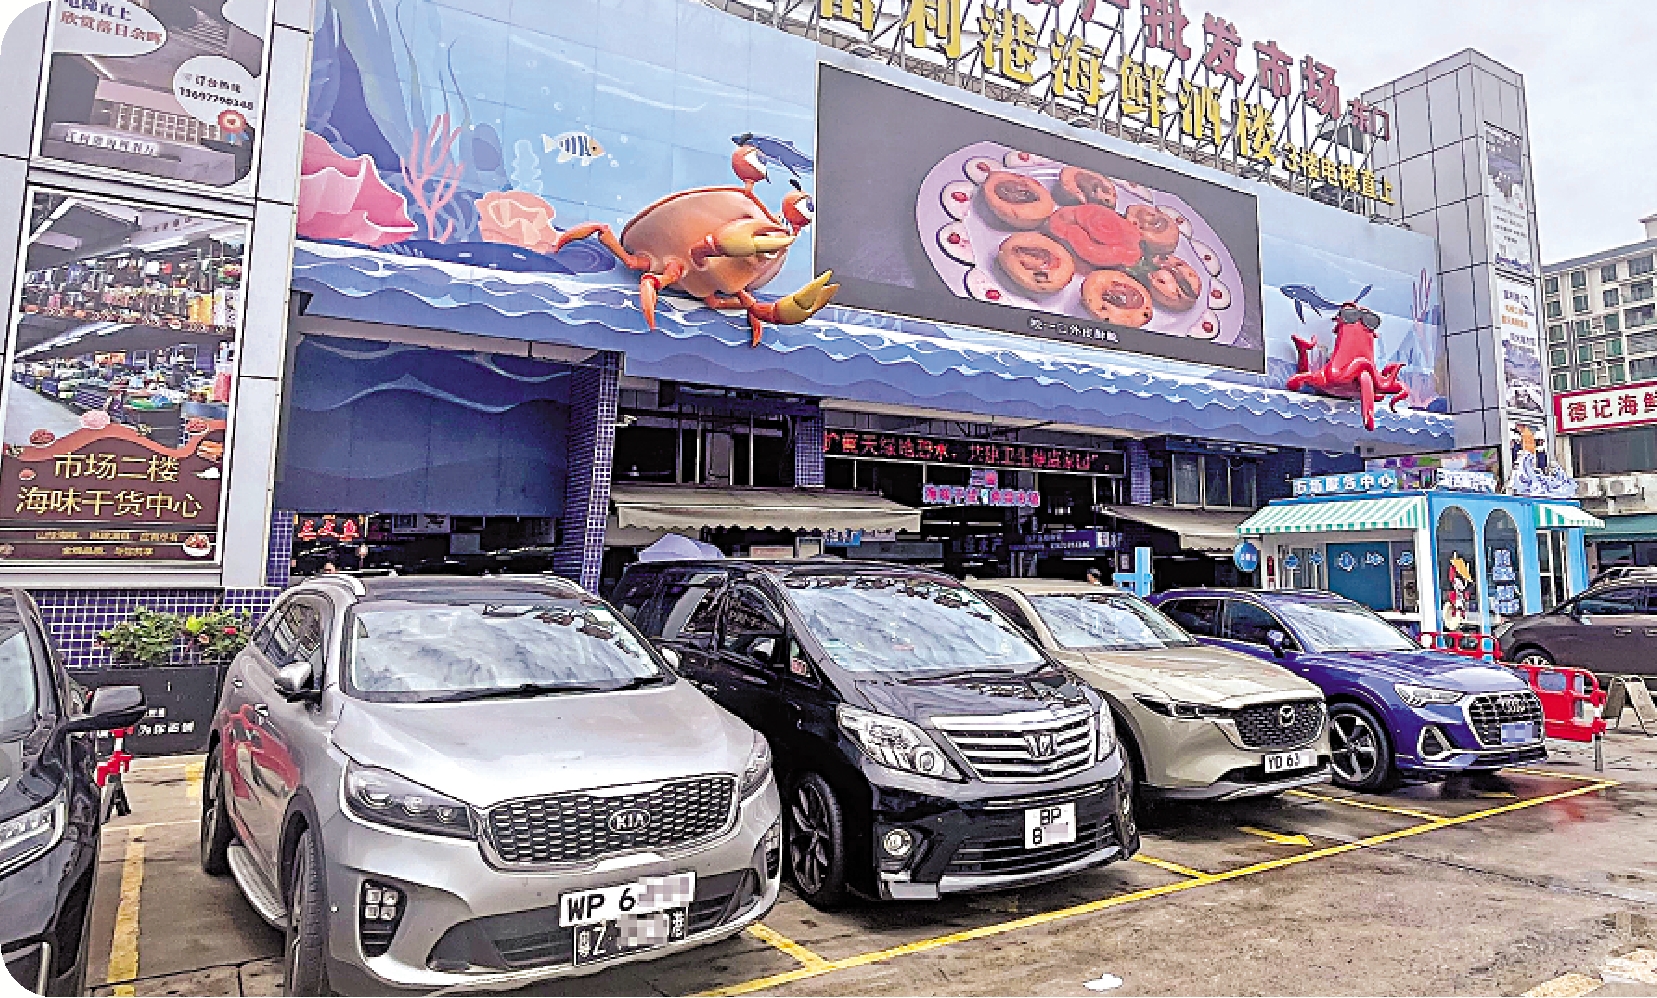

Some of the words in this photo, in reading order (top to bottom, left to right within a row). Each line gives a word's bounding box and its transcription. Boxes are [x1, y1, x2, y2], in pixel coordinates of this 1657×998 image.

[1027, 0, 1340, 119] 批发市场
[53, 451, 180, 482] 市场二楼
[15, 486, 203, 519] 海味干货中心
[615, 813, 645, 830] KIA
[1040, 807, 1061, 825] BP
[568, 893, 605, 922] WP
